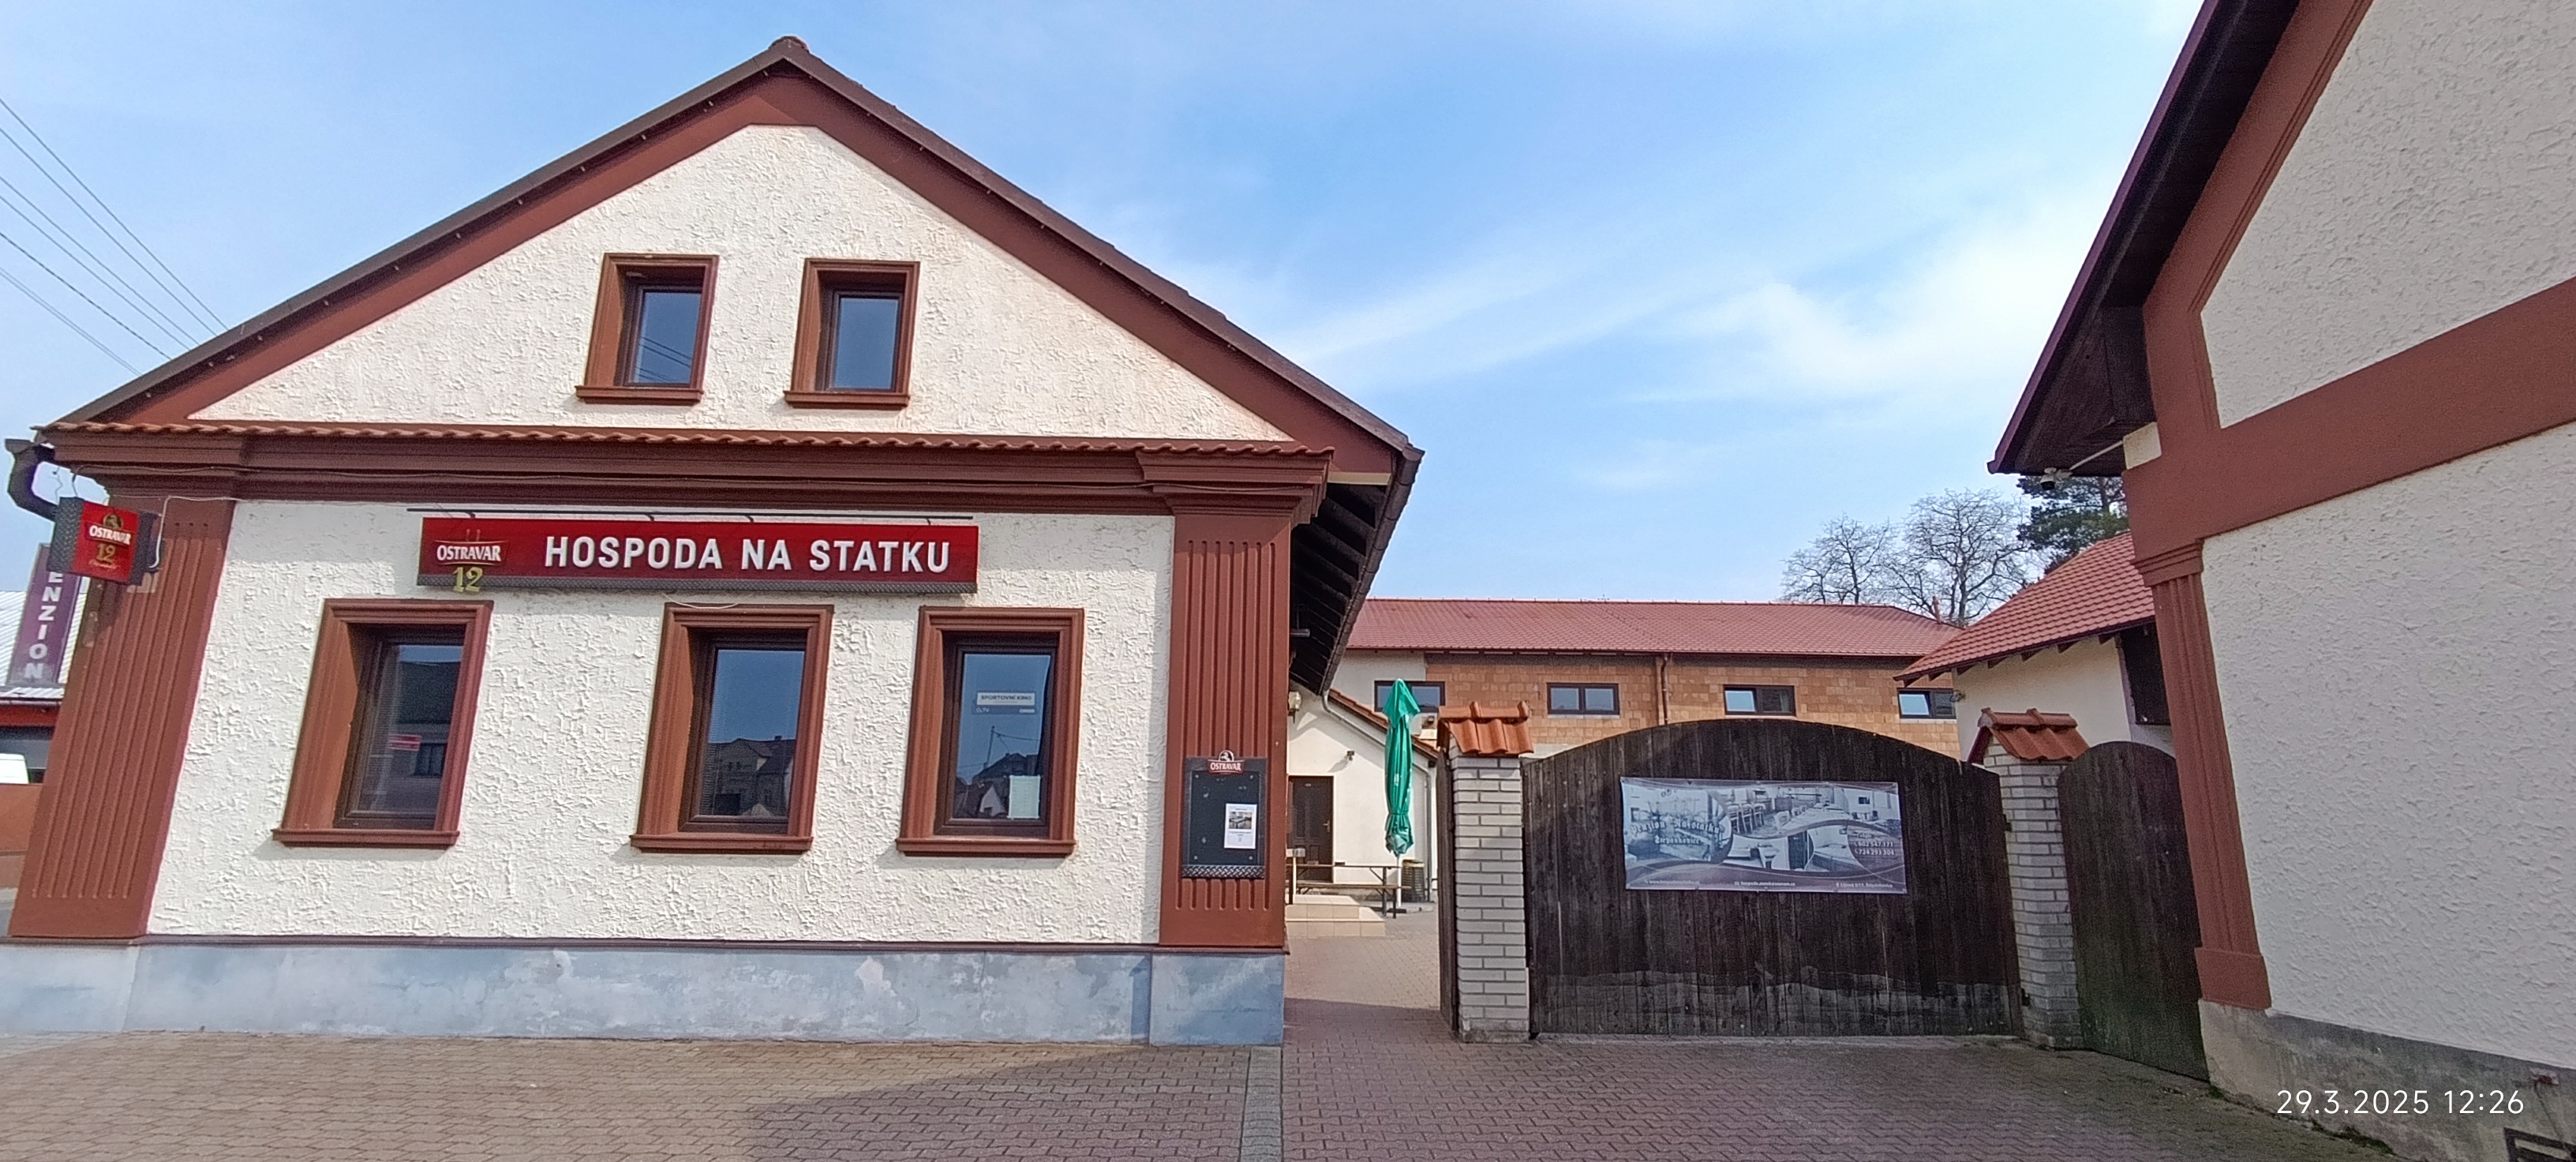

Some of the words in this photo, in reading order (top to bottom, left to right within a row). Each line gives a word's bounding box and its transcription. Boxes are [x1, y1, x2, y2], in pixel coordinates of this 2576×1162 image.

[89, 525, 131, 545] OSTRAVAR
[95, 542, 116, 564] 12
[436, 545, 501, 561] OSTRAVAR
[545, 536, 723, 569] HOSPODA
[741, 538, 792, 571] NA
[809, 540, 949, 573] STATKU
[452, 567, 483, 593] 12
[24, 571, 64, 679] ENZION
